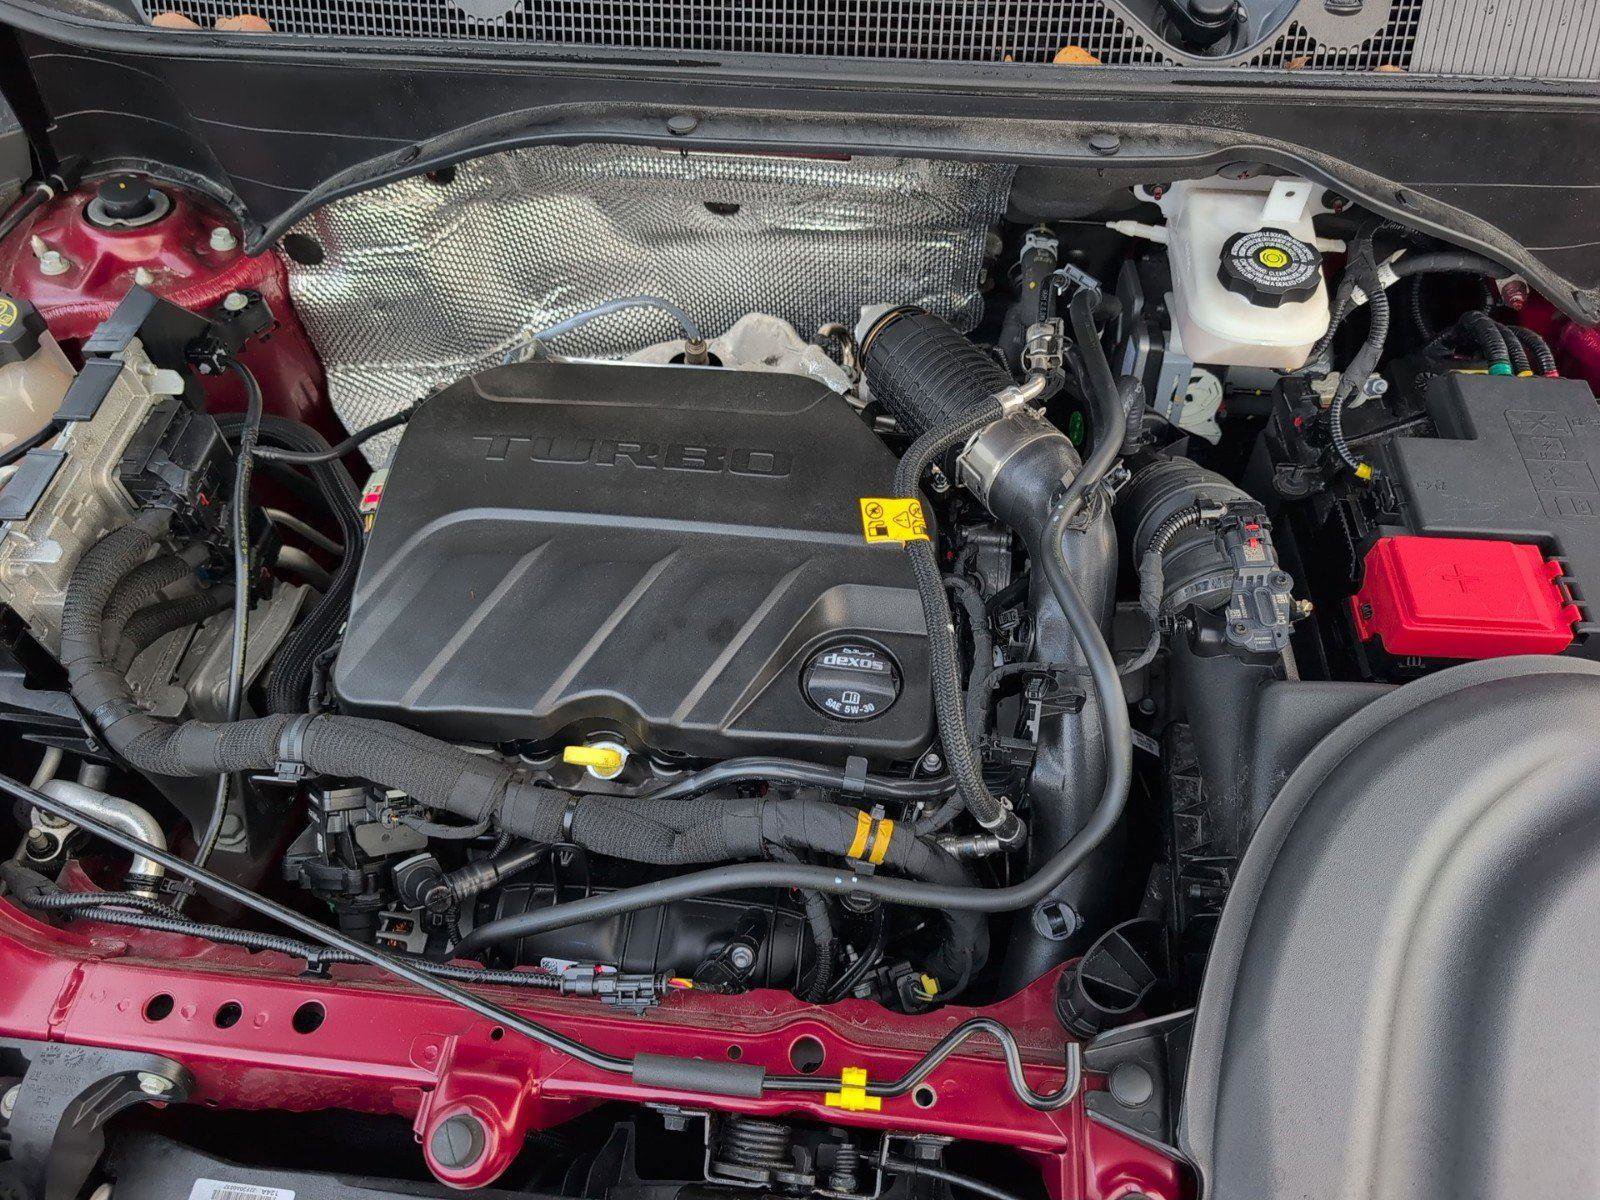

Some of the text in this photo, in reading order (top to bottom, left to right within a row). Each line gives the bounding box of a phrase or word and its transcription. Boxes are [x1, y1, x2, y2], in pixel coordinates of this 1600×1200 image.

[473, 436, 794, 478] TURBO
[823, 653, 884, 671] dexos
[825, 698, 875, 714] SAE 5W-30
